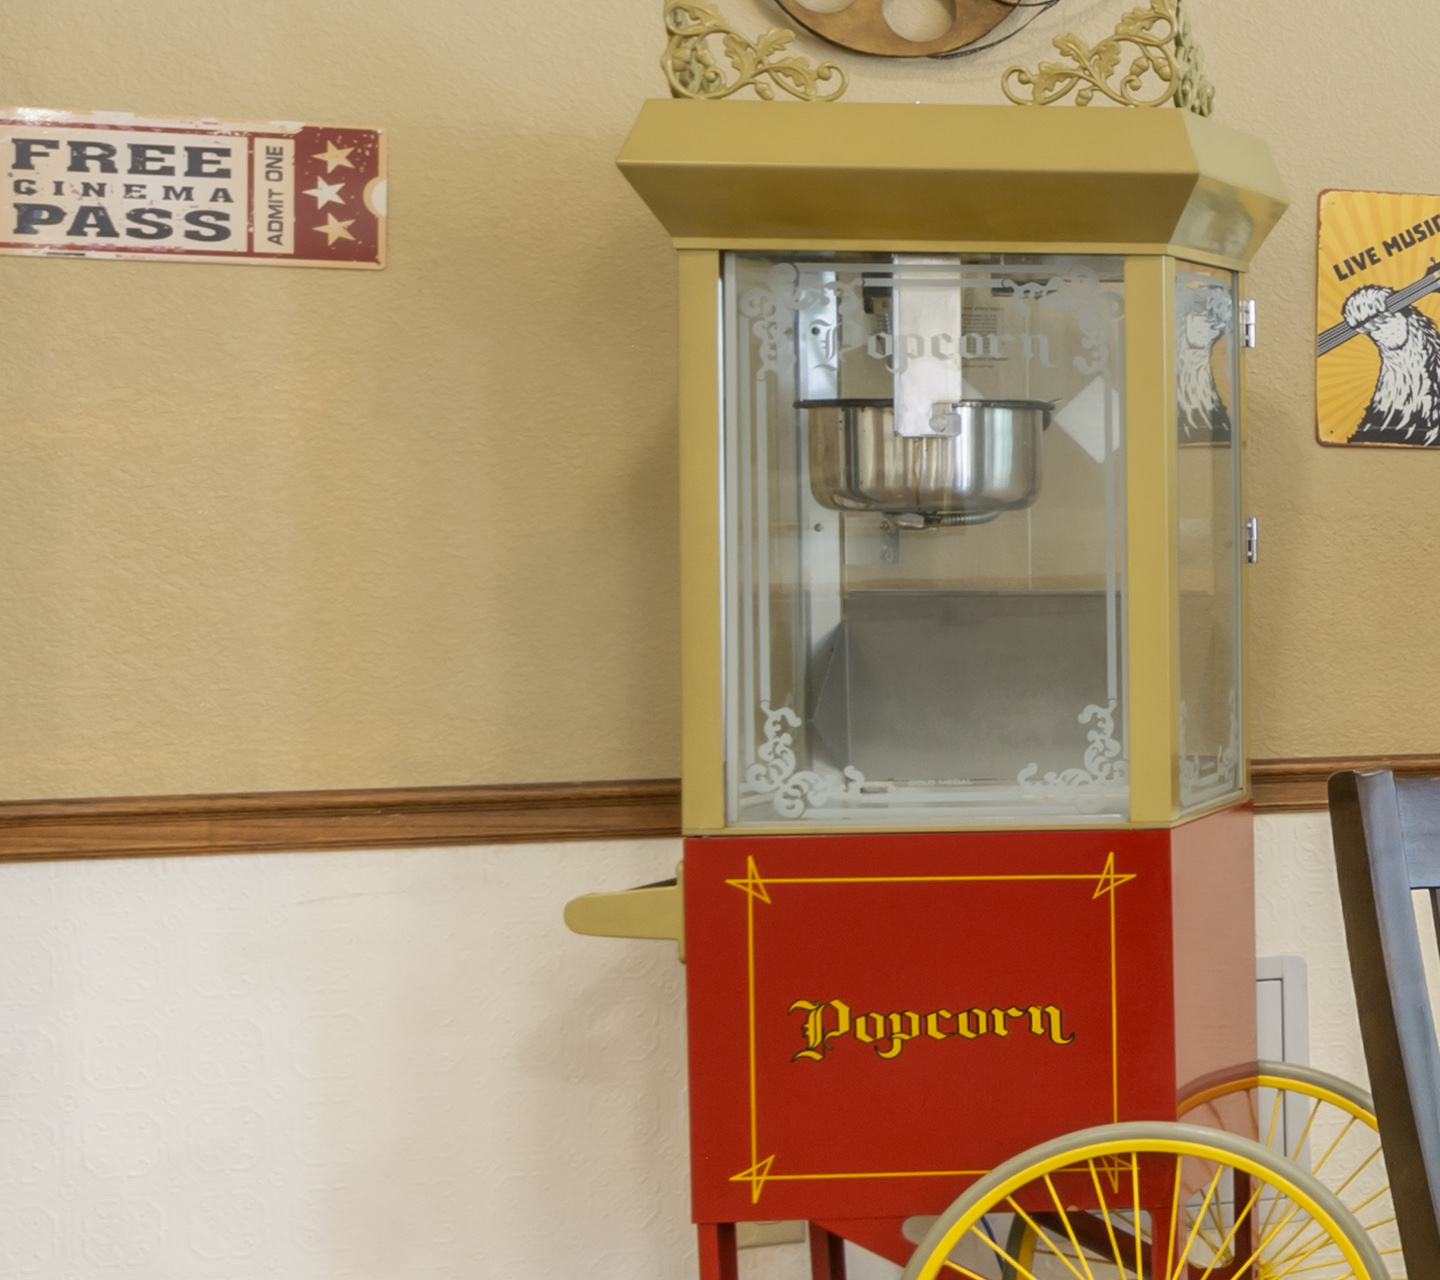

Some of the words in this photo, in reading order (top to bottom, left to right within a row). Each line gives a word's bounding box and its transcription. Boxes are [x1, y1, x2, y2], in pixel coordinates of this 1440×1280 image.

[12, 138, 232, 178] FREE
[265, 146, 284, 182] ONE
[13, 179, 234, 203] CINEMA
[13, 203, 231, 242] PASS
[267, 189, 284, 246] ADMIT
[1333, 244, 1381, 281] LIVE
[809, 319, 1060, 374] Popcorn
[788, 999, 1075, 1062] Popcorn
